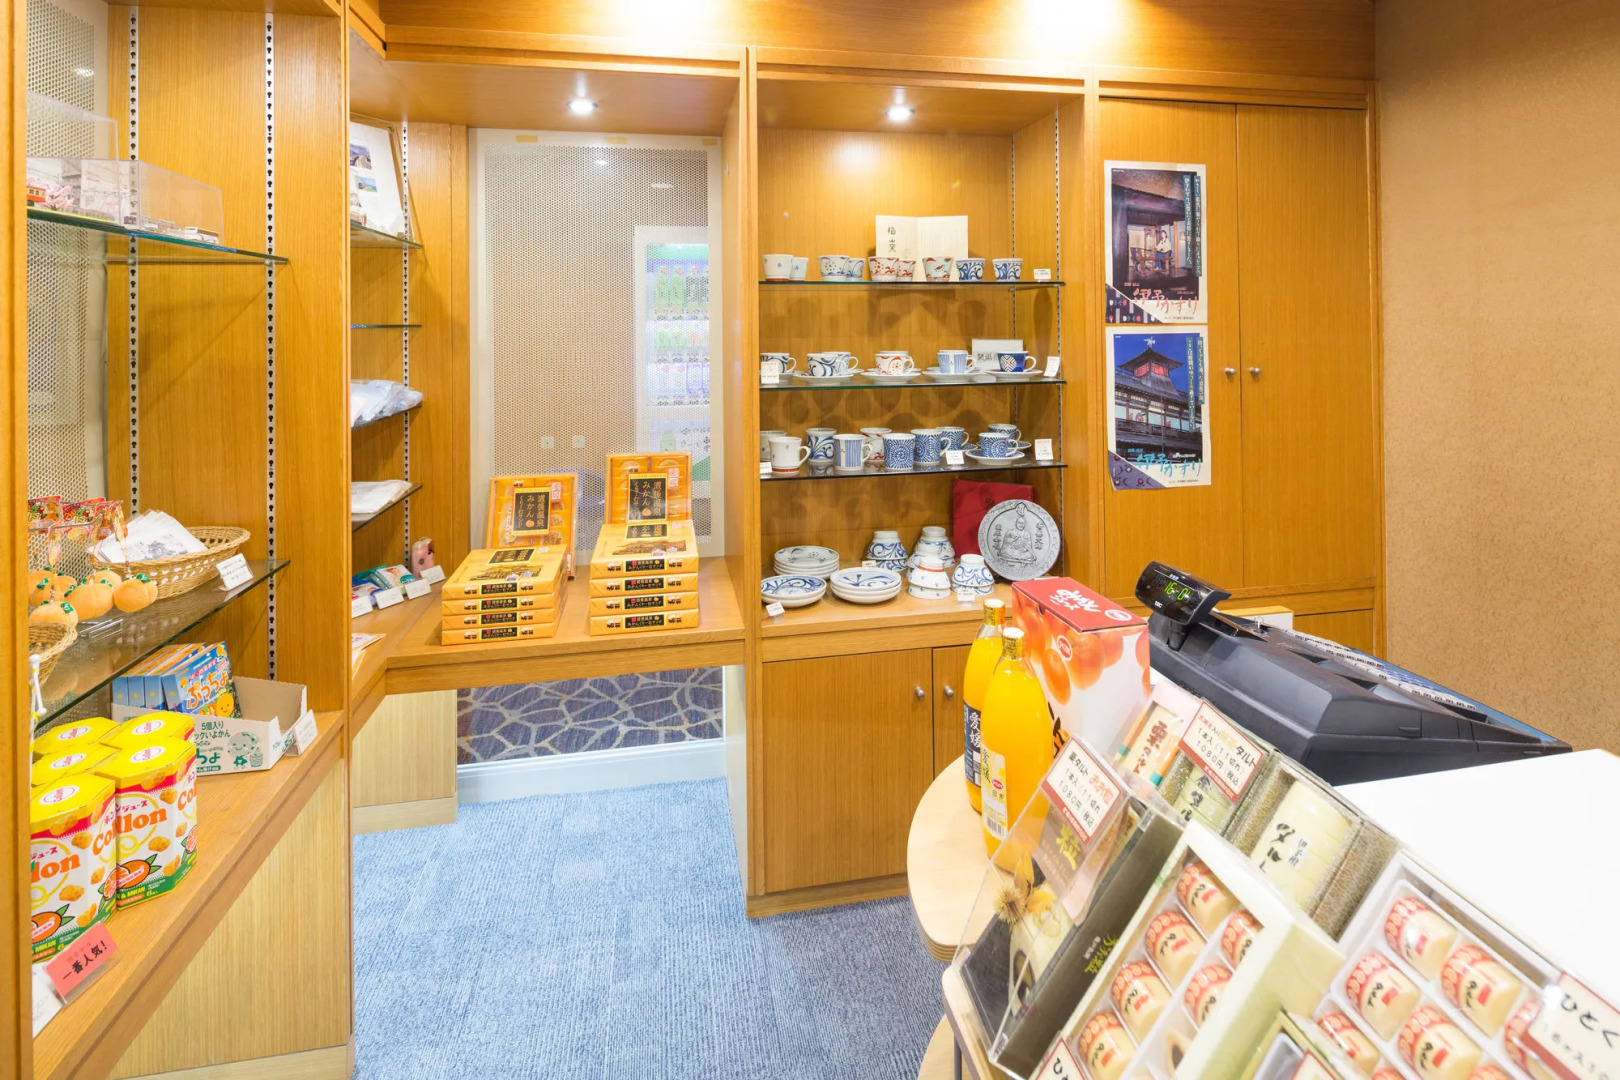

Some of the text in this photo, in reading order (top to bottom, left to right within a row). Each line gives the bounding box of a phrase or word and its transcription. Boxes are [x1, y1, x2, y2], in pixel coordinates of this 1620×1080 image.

[187, 671, 228, 709] ぷっちょ
[62, 940, 108, 980] 一番人気!
